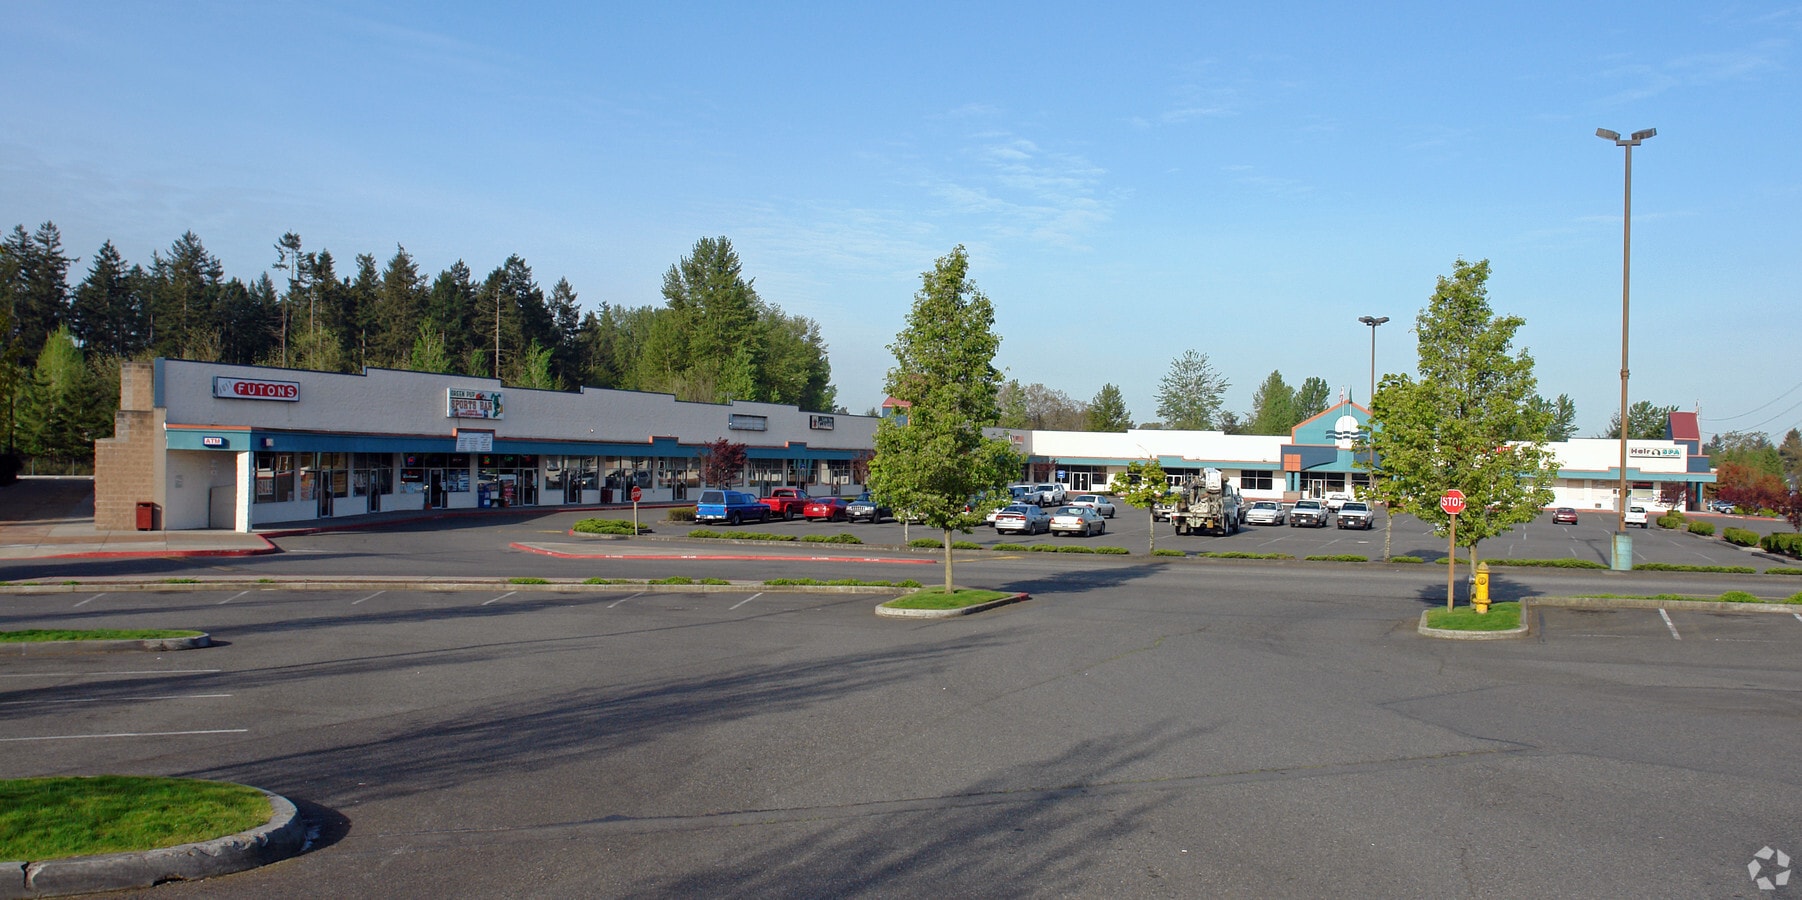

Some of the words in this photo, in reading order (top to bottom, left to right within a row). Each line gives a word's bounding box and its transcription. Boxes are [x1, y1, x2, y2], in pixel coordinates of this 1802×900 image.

[237, 383, 295, 397] FUTONS
[451, 399, 477, 410] SPORTS
[480, 401, 493, 411] BAR
[1441, 496, 1464, 507] STOP
